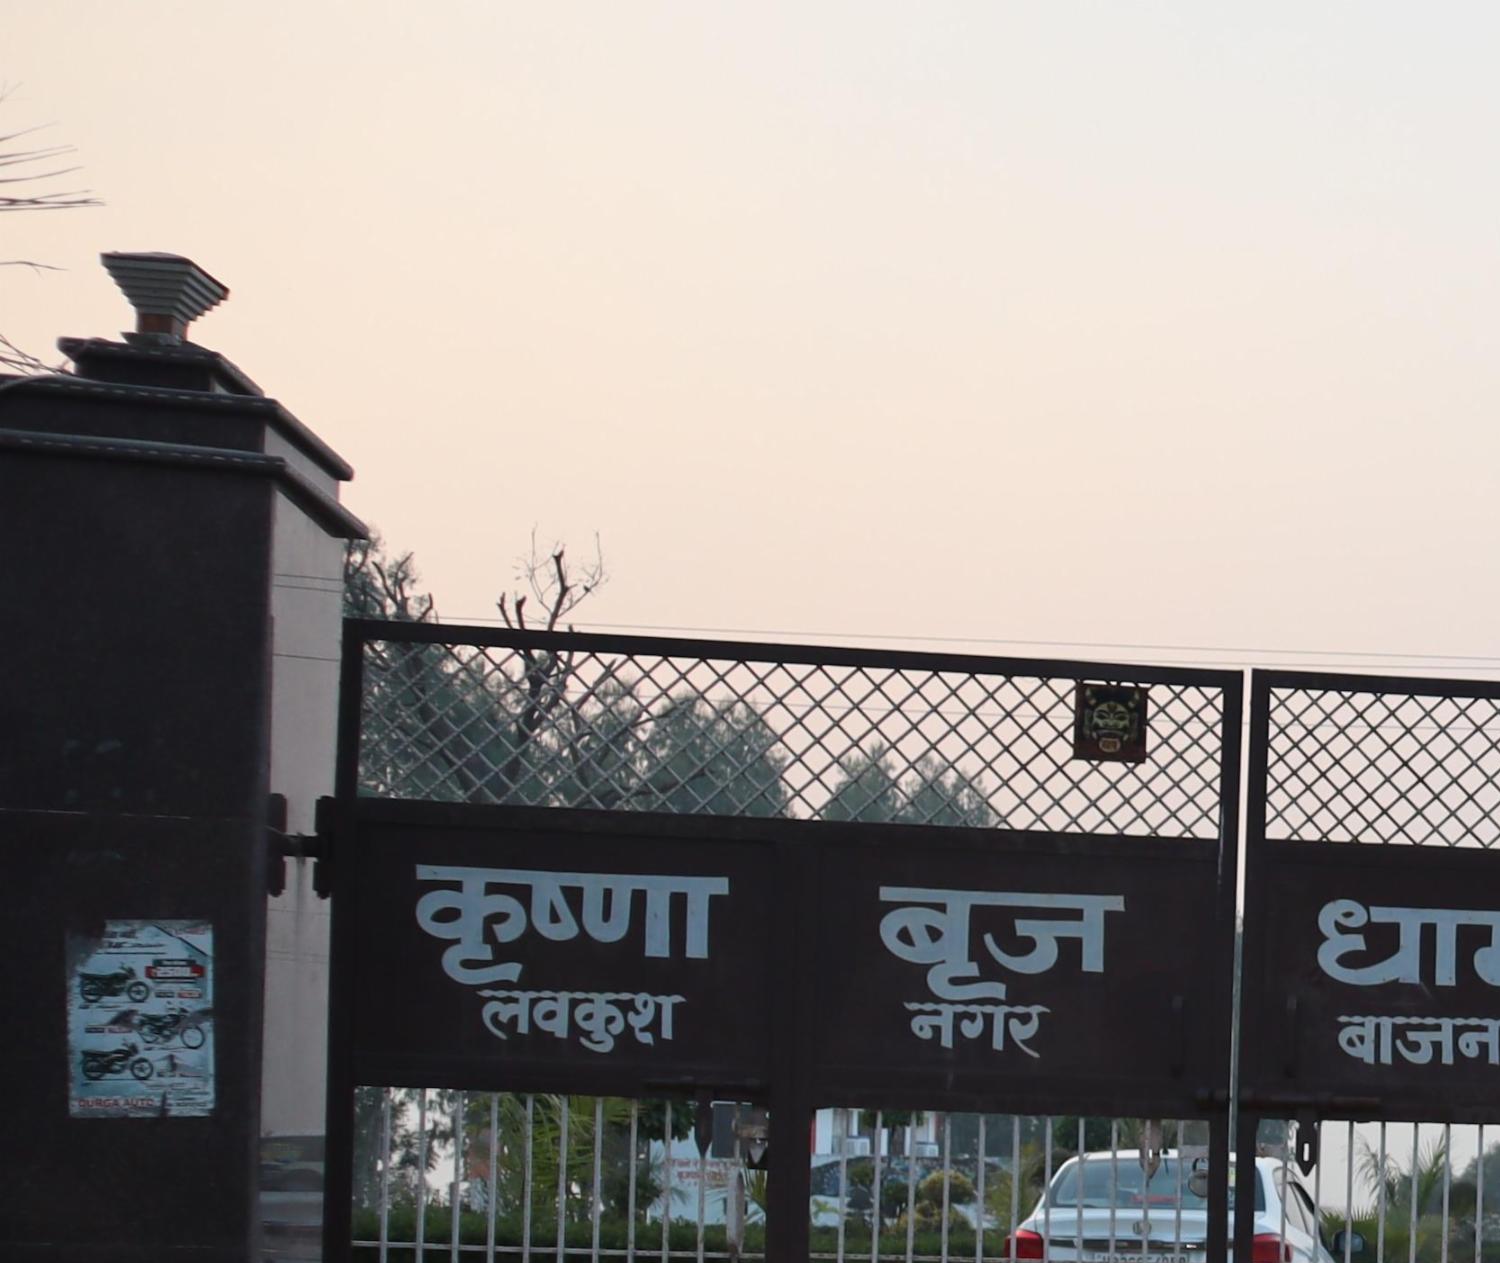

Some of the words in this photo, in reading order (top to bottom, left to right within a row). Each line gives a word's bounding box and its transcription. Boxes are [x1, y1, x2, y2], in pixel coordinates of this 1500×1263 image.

[415, 864, 730, 985] कृष्णा
[879, 886, 1126, 1001] बृज
[476, 989, 687, 1053] लवकुश
[903, 1002, 1051, 1058] नगर
